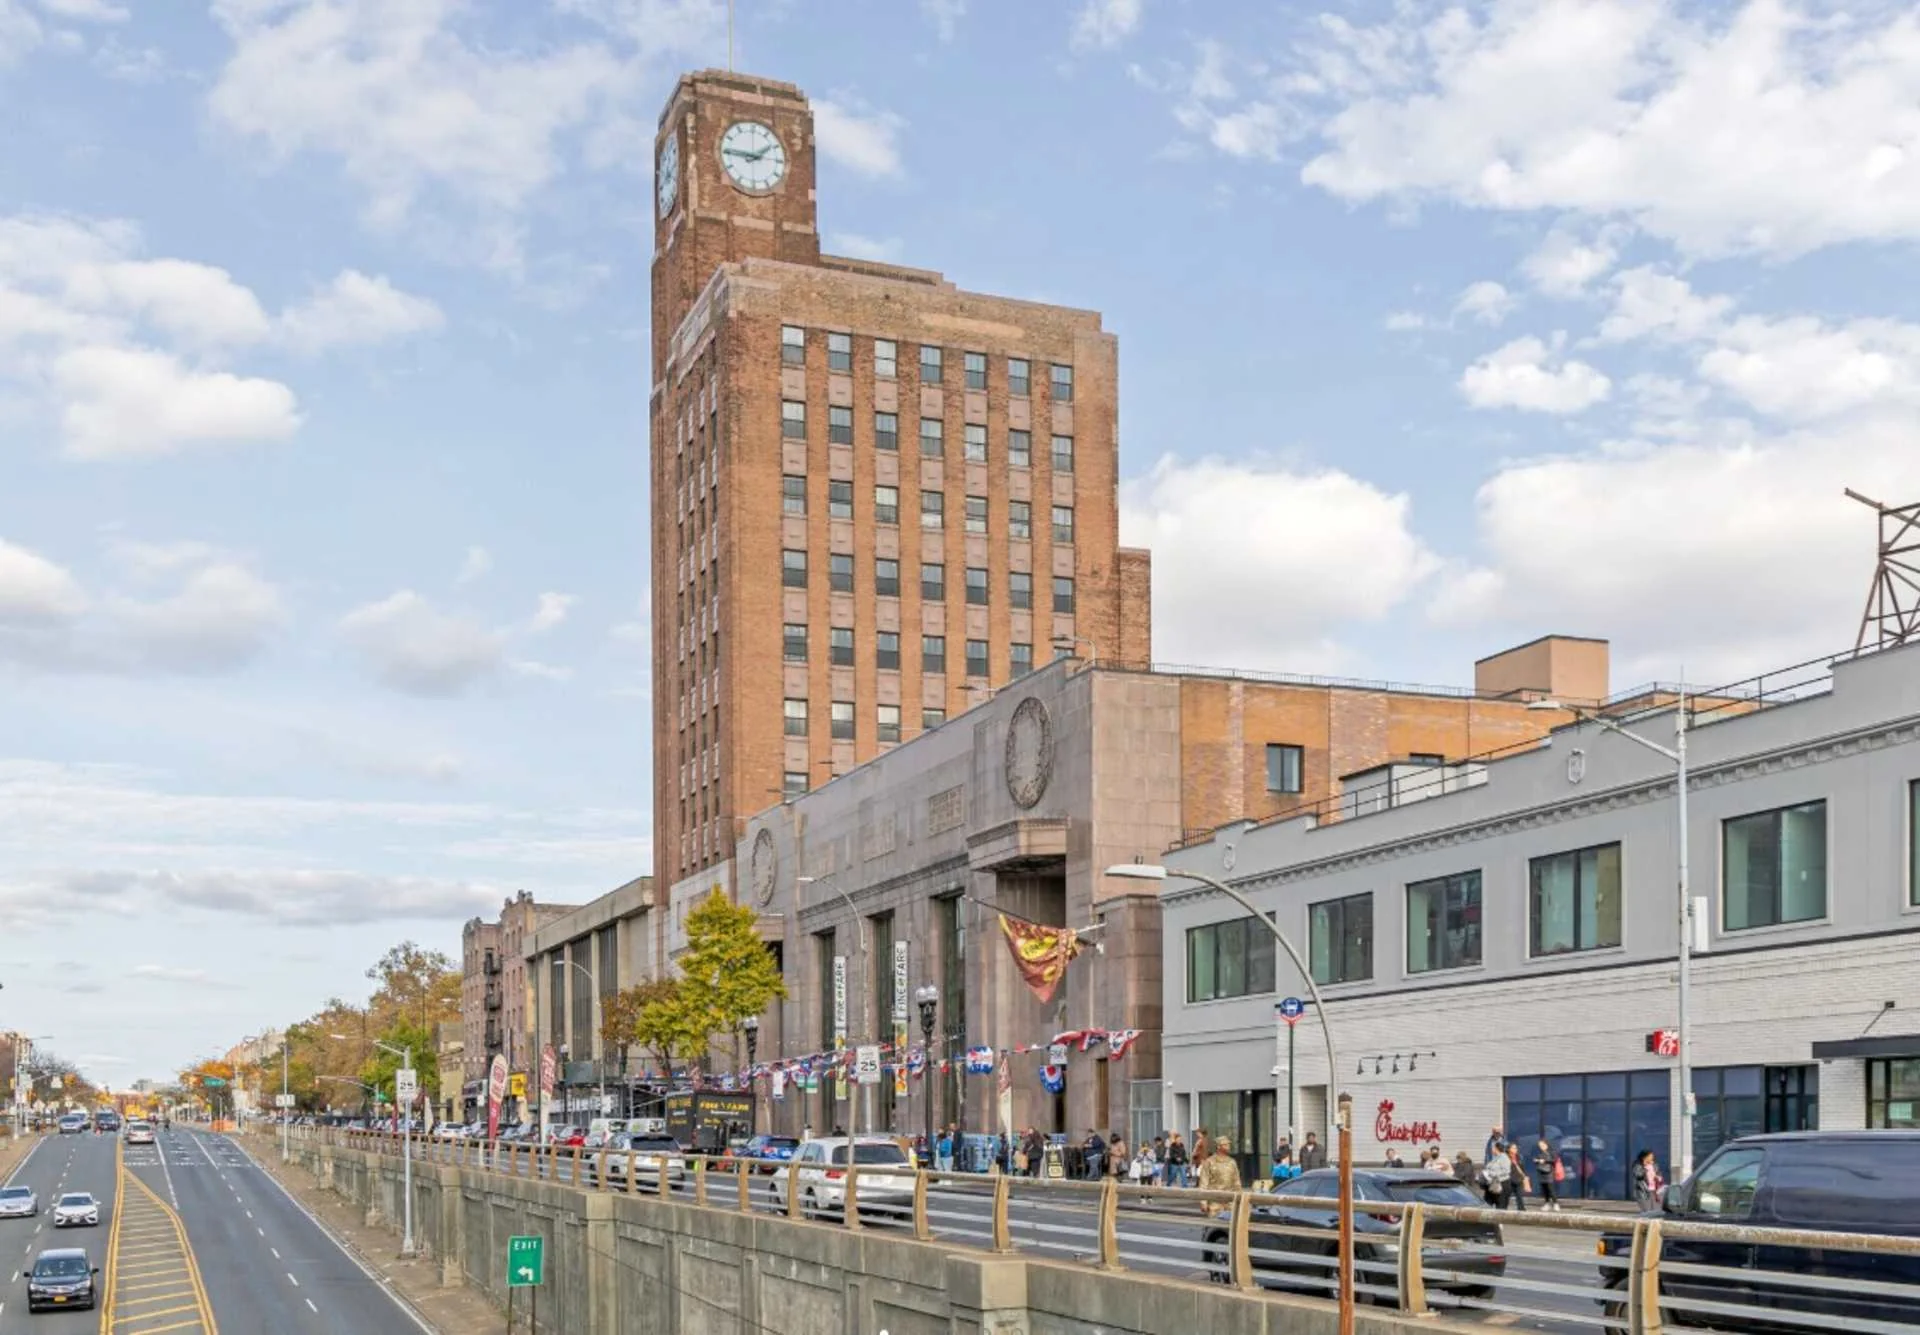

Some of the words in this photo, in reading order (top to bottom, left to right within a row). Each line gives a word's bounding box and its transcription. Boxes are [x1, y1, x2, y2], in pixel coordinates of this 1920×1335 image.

[896, 947, 906, 976] FARE
[896, 988, 906, 1012] FINE
[860, 1060, 877, 1072] 25
[514, 1240, 537, 1250] EXIT
